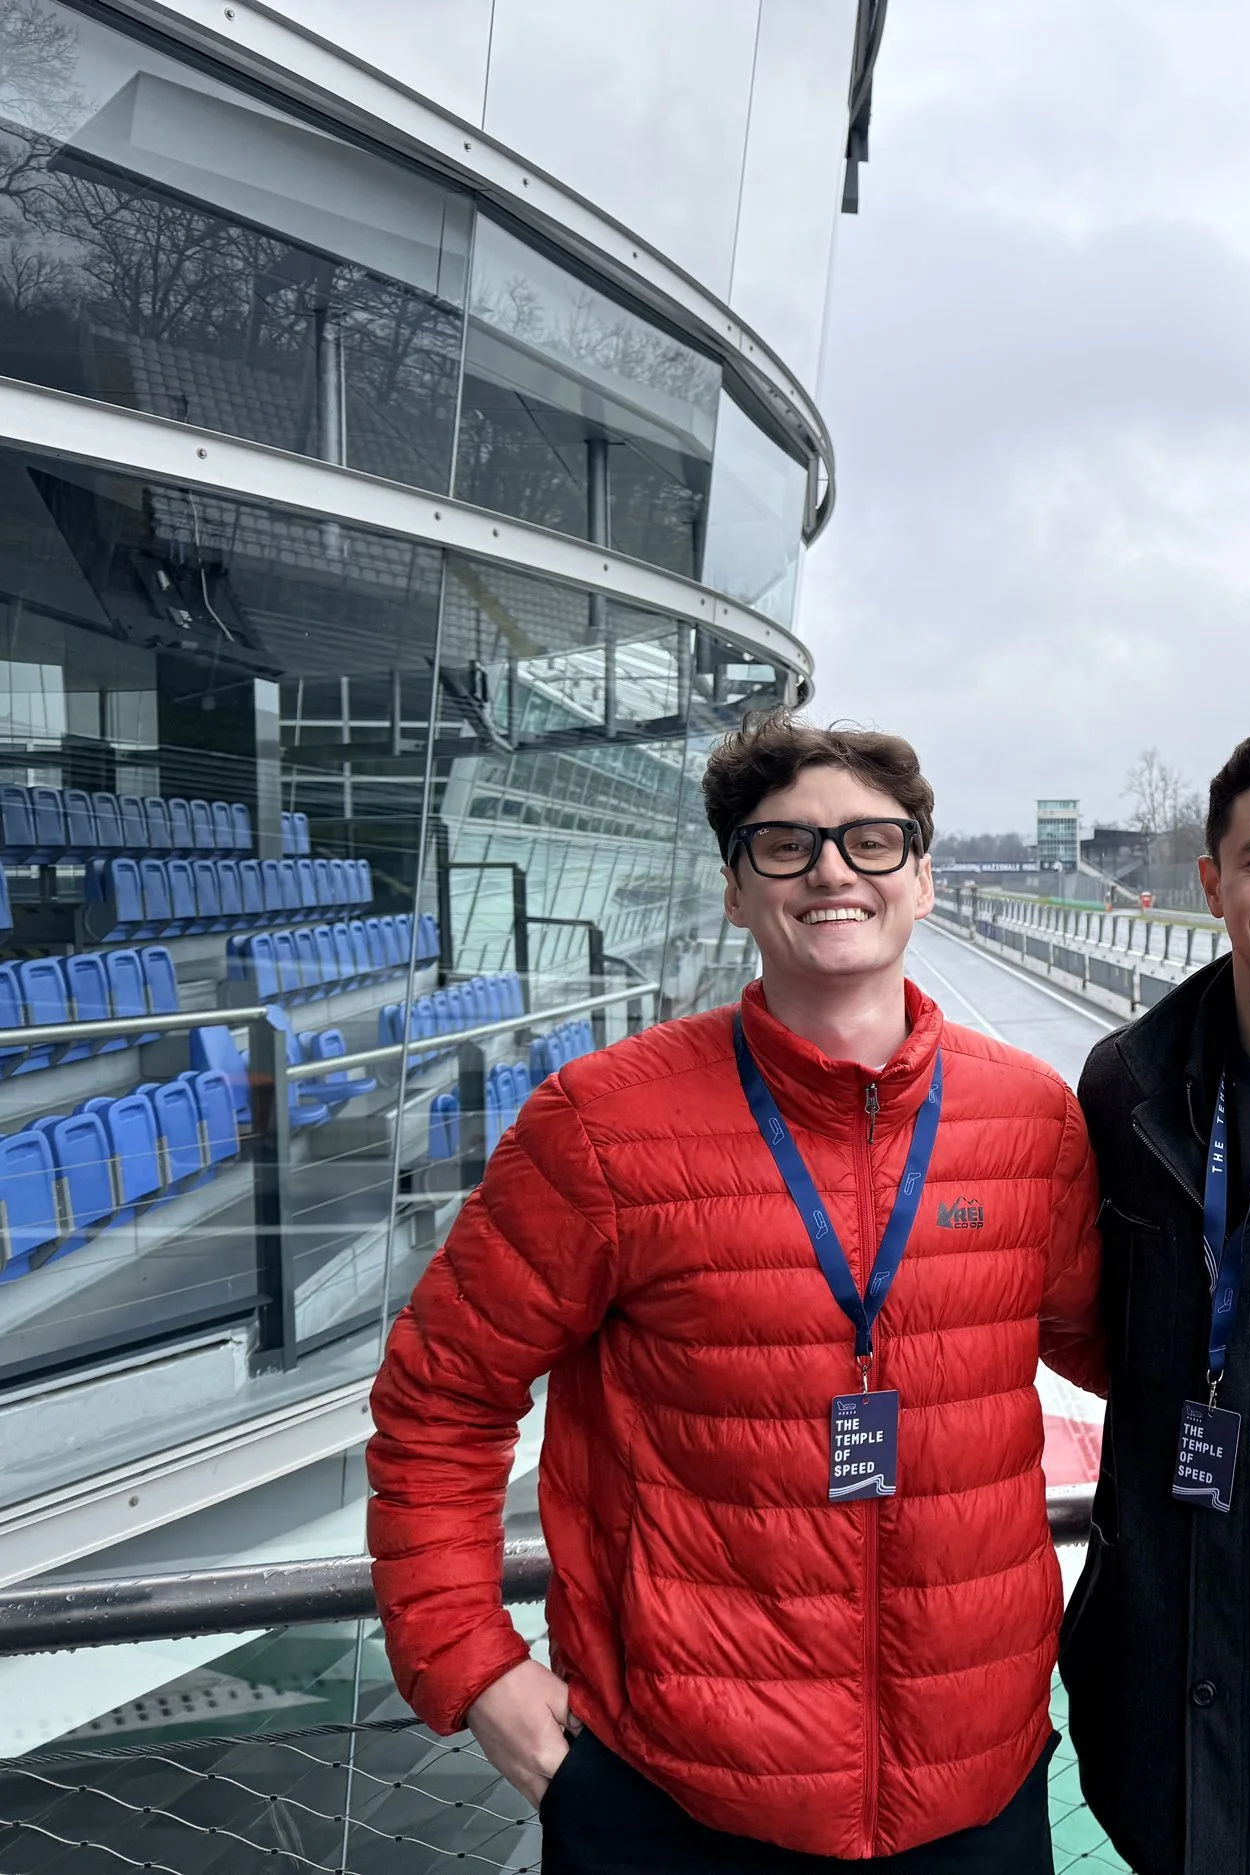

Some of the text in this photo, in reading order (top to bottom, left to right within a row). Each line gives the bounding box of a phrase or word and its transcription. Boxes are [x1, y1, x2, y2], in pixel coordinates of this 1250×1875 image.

[1212, 1141, 1224, 1174] THE
[954, 1207, 984, 1222] REI
[836, 1418, 860, 1432] THE
[1183, 1423, 1204, 1439] THE
[835, 1430, 884, 1447] TEMPLE
[1182, 1437, 1224, 1458] TEMPLE
[834, 1449, 851, 1463] OF
[1179, 1451, 1194, 1464] OF
[834, 1462, 875, 1478] SPEED
[1177, 1465, 1213, 1484] SPEED
